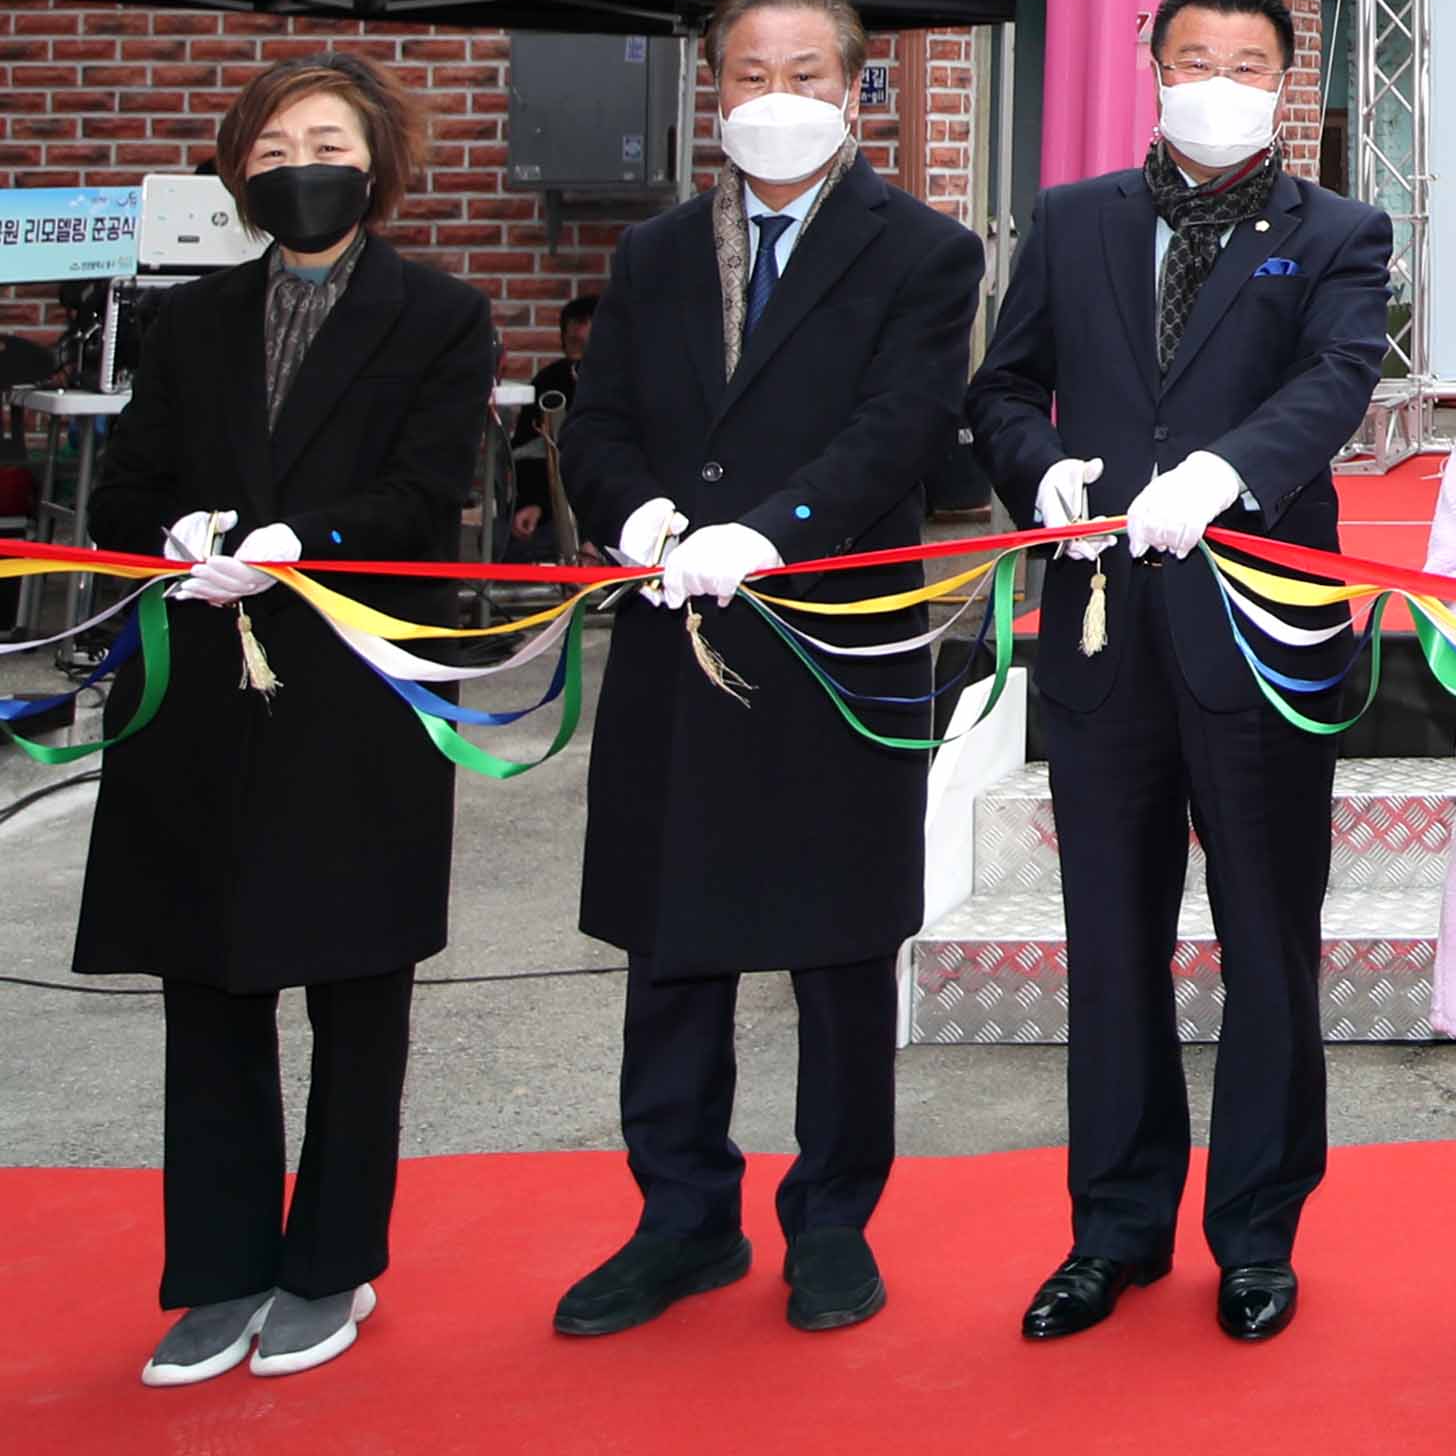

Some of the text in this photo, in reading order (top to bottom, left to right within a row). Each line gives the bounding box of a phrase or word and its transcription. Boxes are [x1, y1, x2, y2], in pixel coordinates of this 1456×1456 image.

[0, 215, 136, 245] 원 리모델링 준공식
